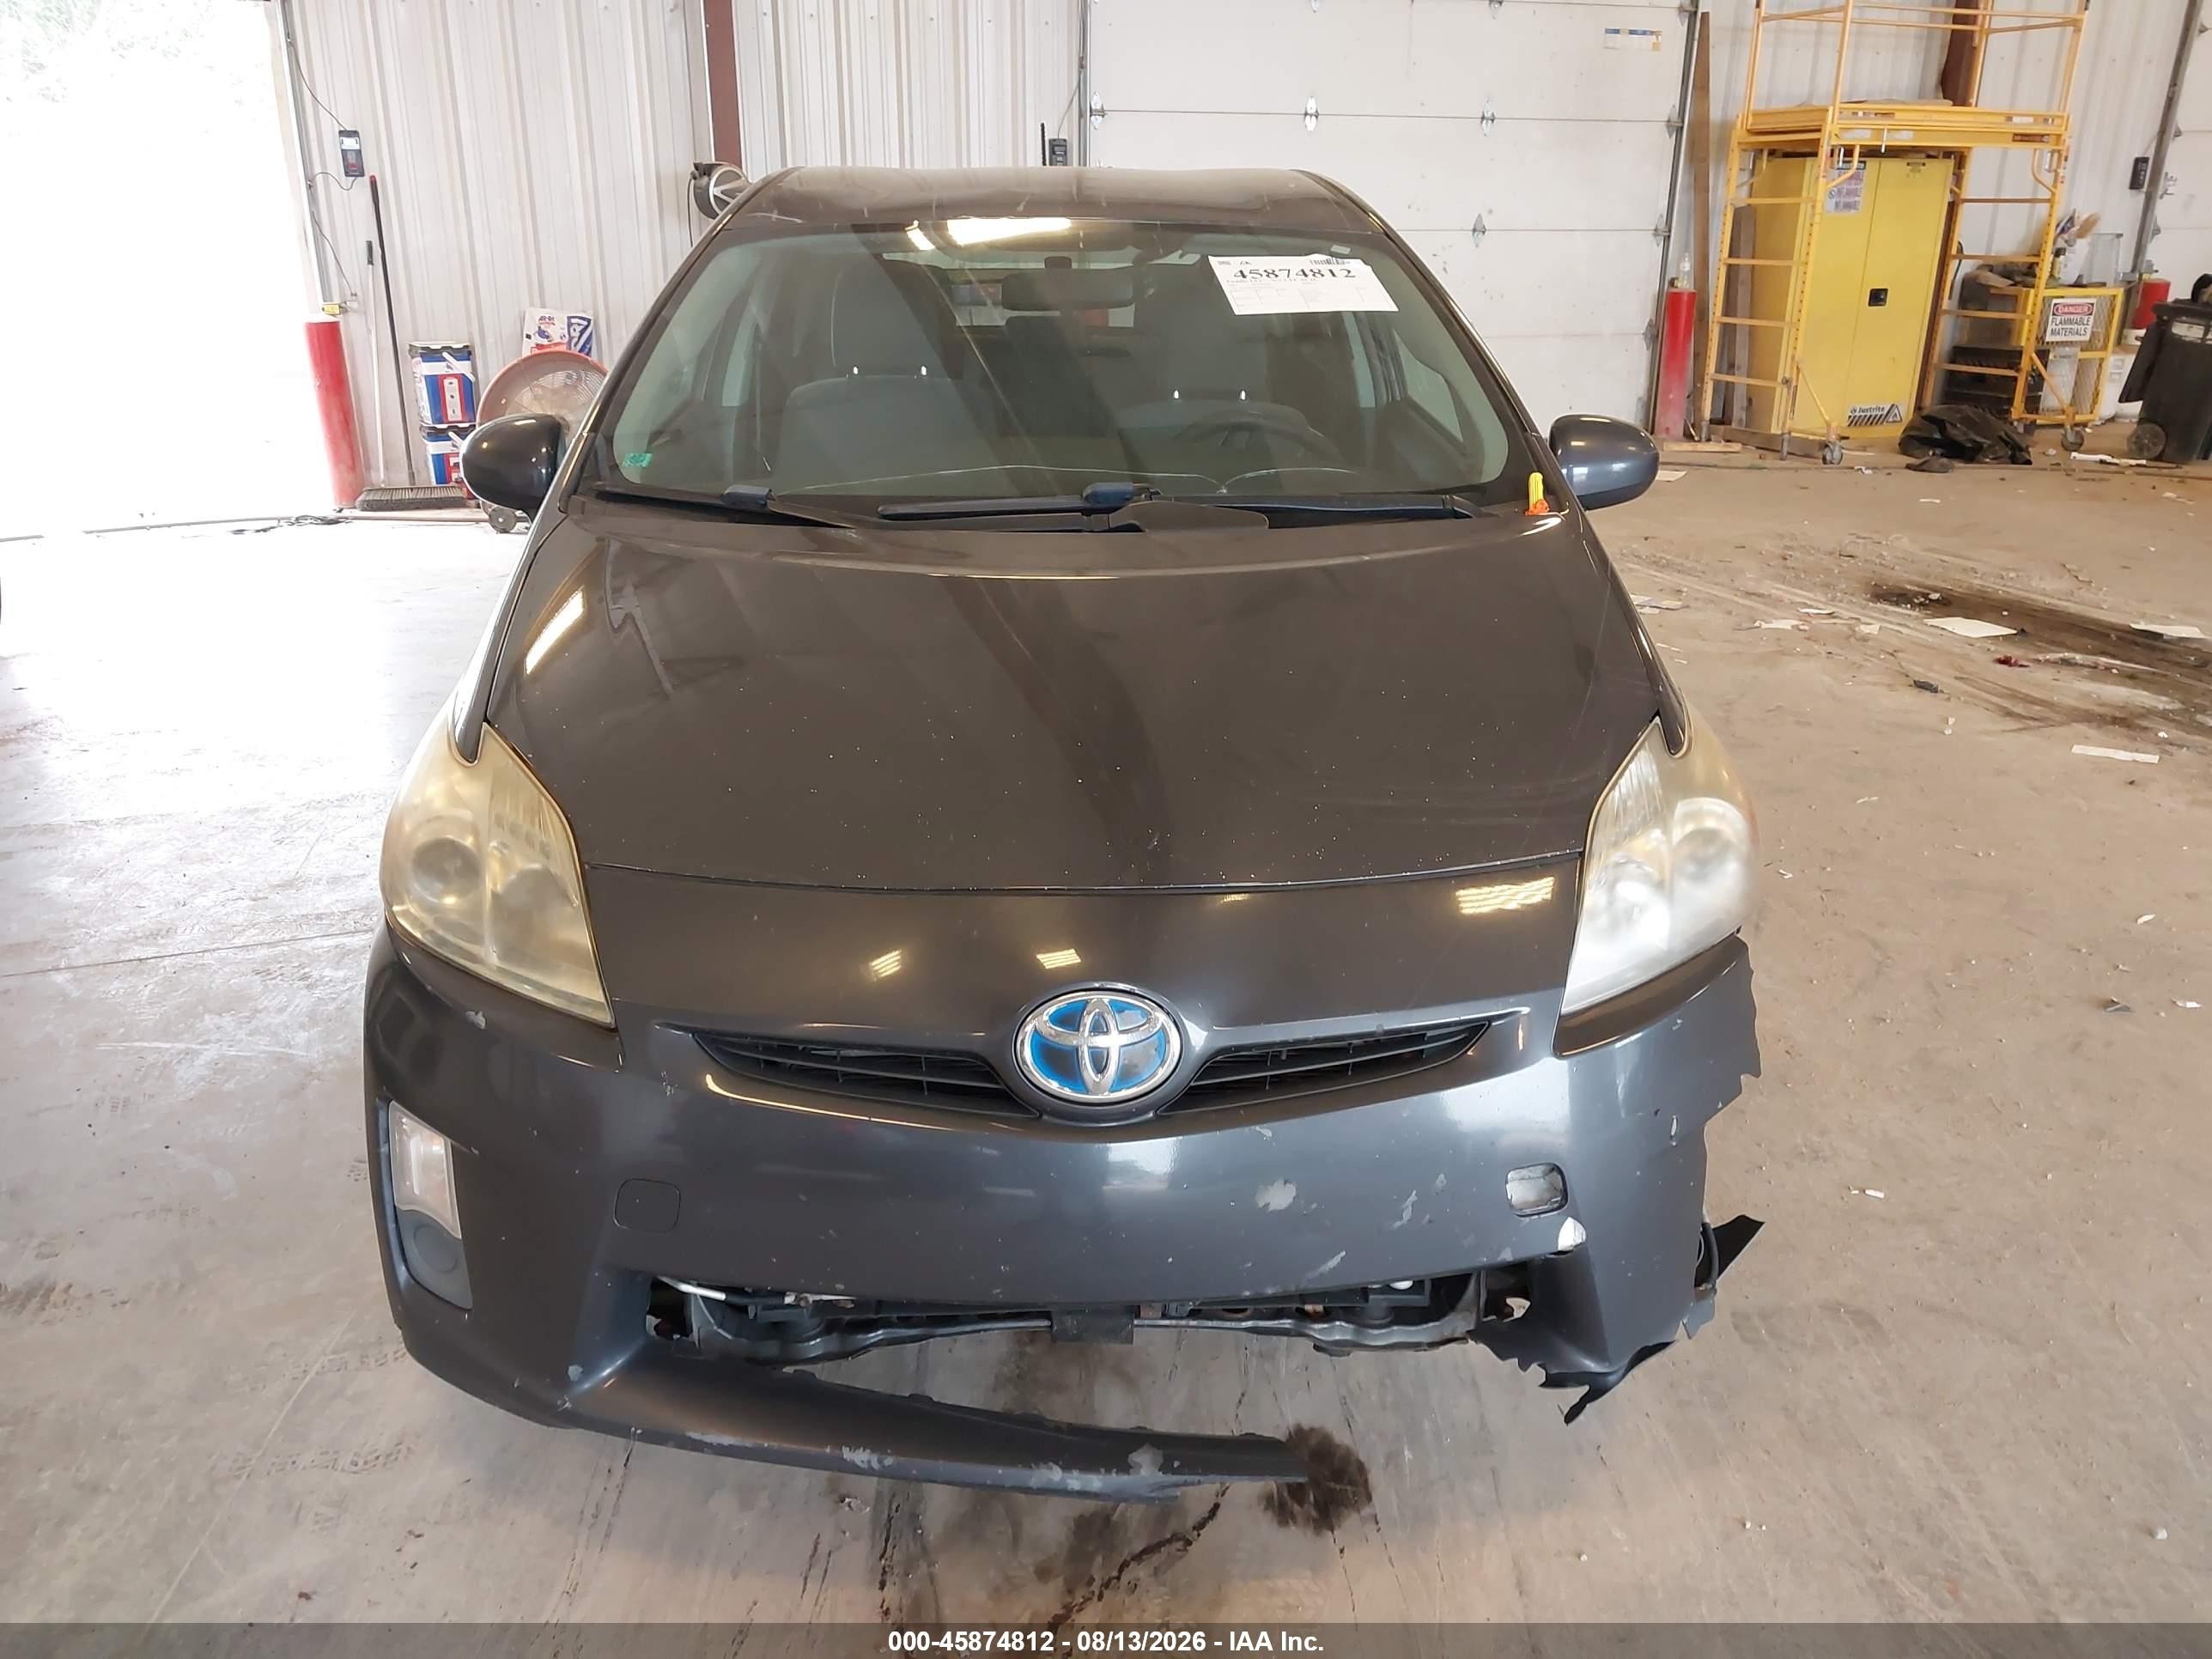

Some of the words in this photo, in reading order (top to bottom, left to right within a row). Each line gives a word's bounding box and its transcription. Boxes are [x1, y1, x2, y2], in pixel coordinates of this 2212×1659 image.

[1234, 267, 1356, 279] 45874812
[2051, 317, 2090, 325] FLAMMABLE
[2051, 327, 2087, 336] MATERIALS
